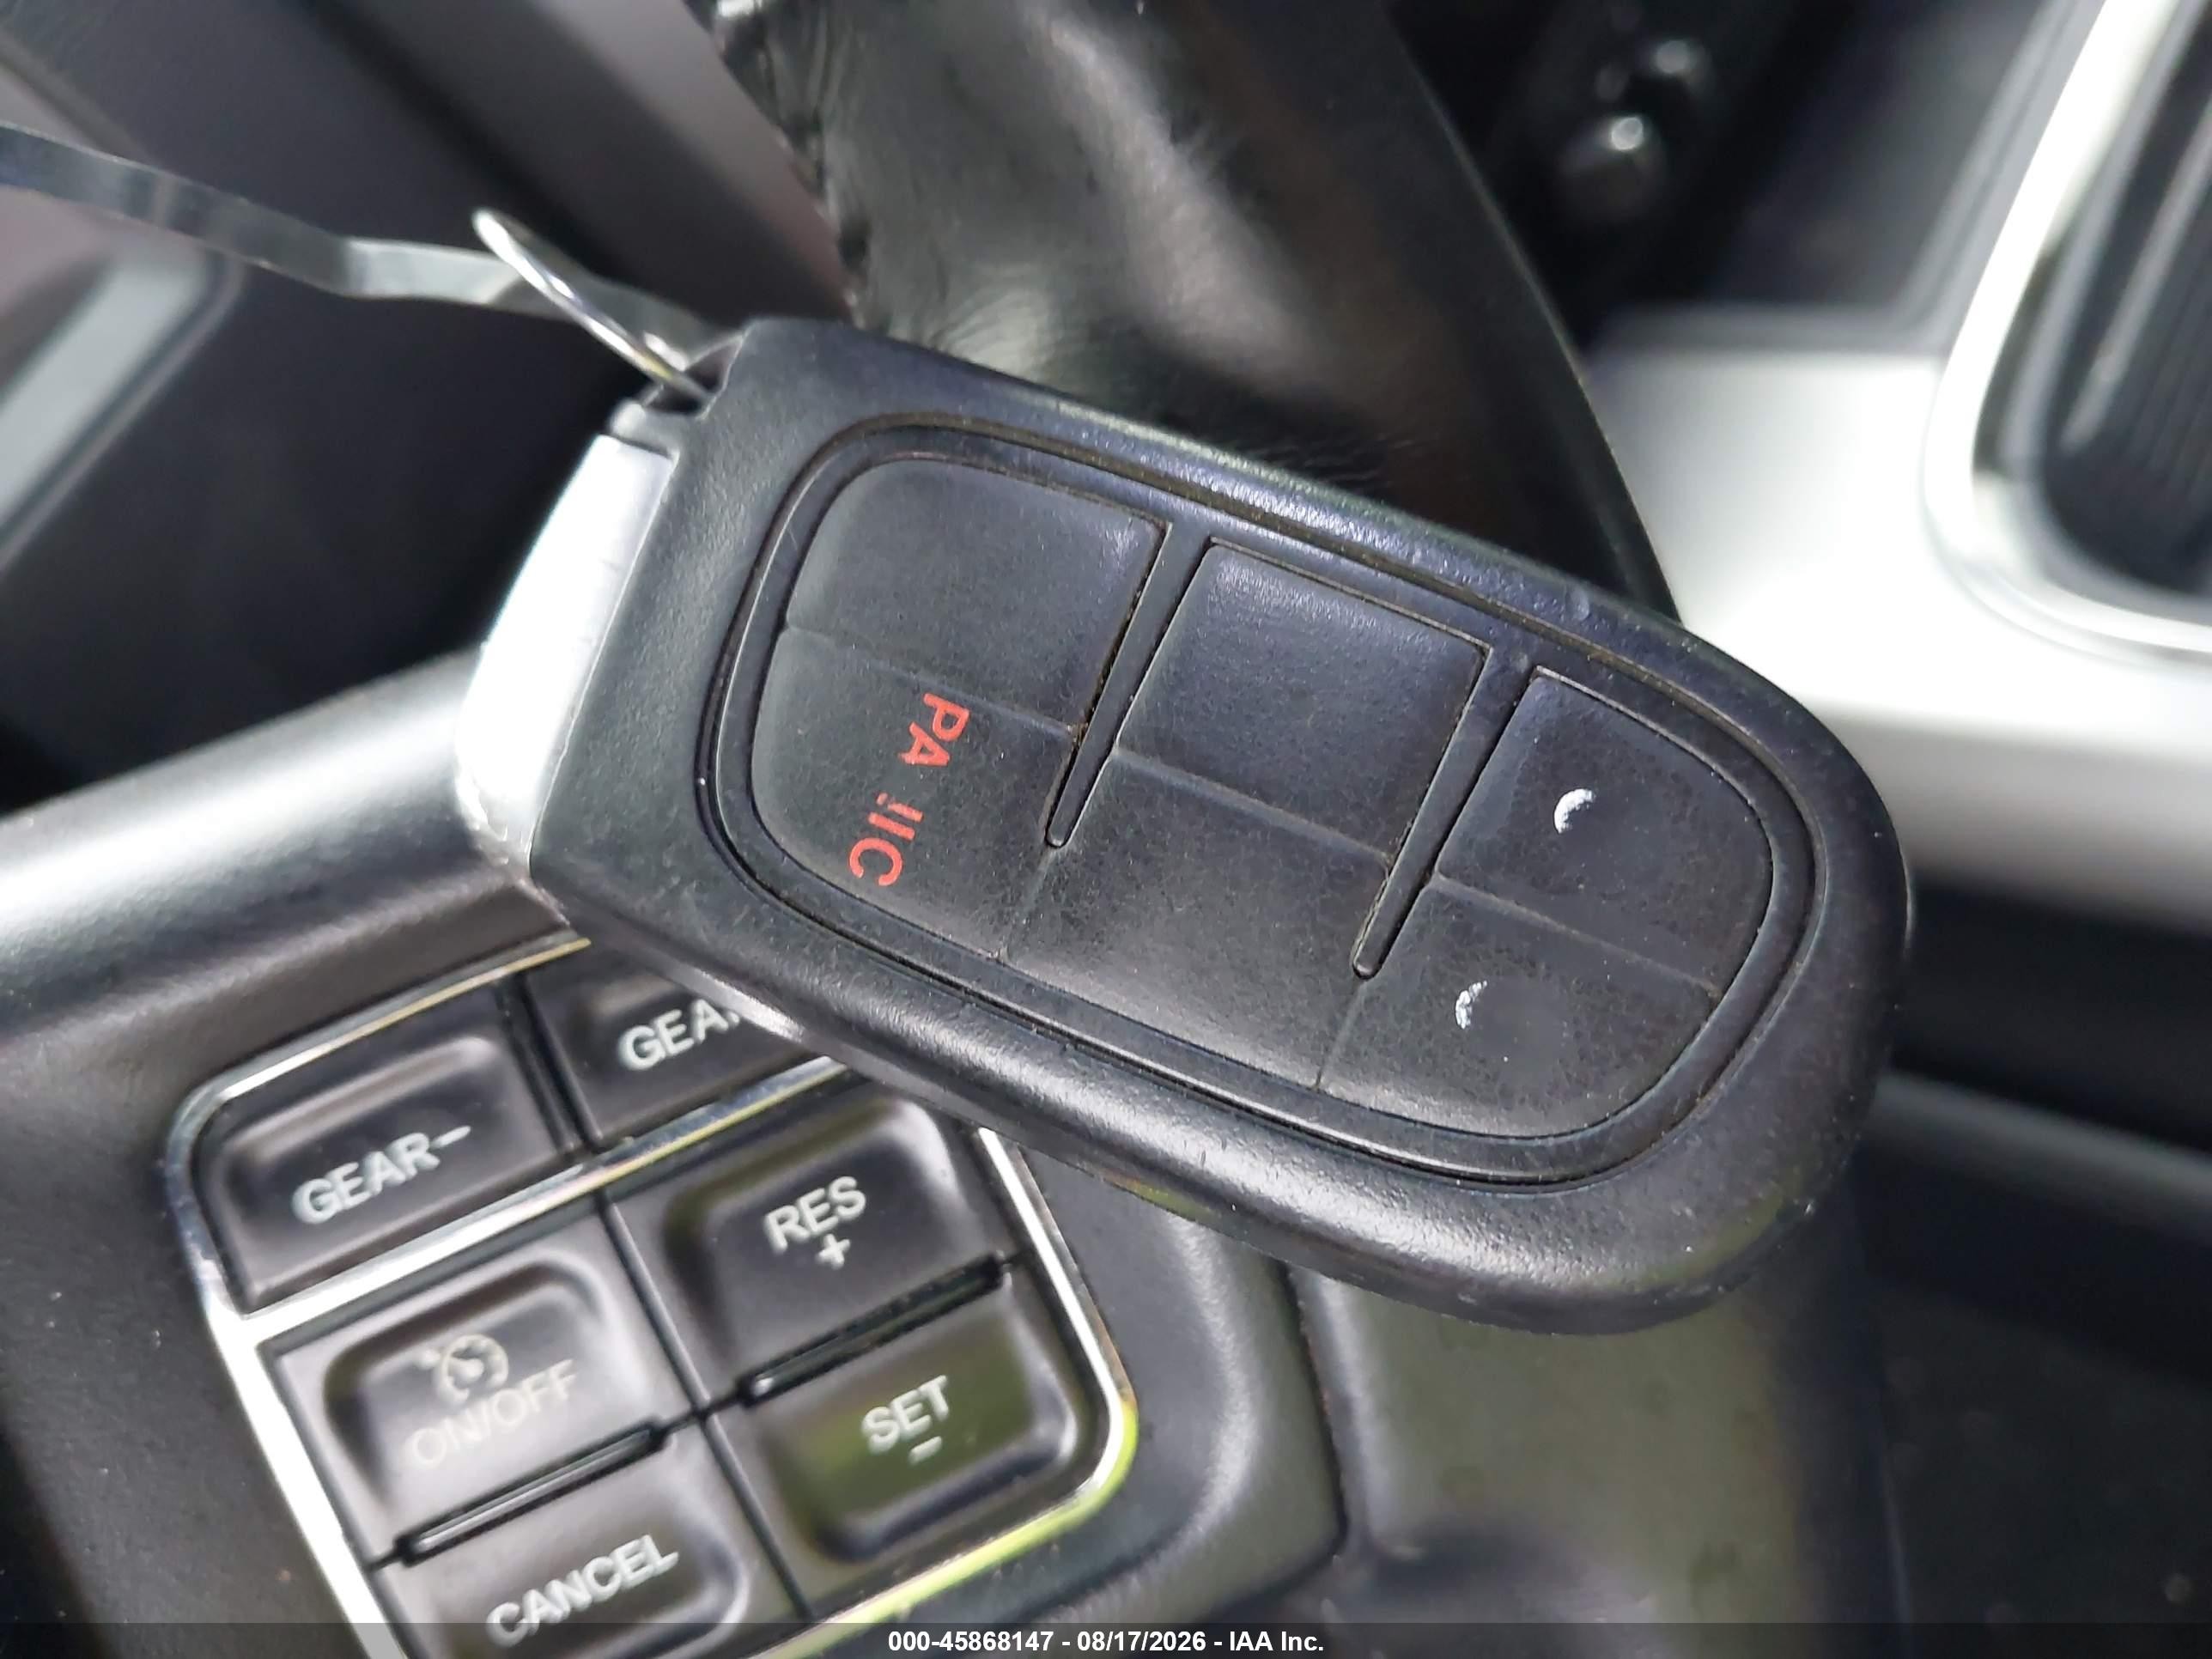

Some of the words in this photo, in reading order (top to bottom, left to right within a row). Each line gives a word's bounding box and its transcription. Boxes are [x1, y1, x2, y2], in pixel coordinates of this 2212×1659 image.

[618, 999, 740, 1071] GEA
[764, 1176, 866, 1254] RES
[404, 1358, 576, 1468] ON/OFF
[861, 1375, 950, 1455] SET
[485, 1534, 679, 1647] CANCEL
